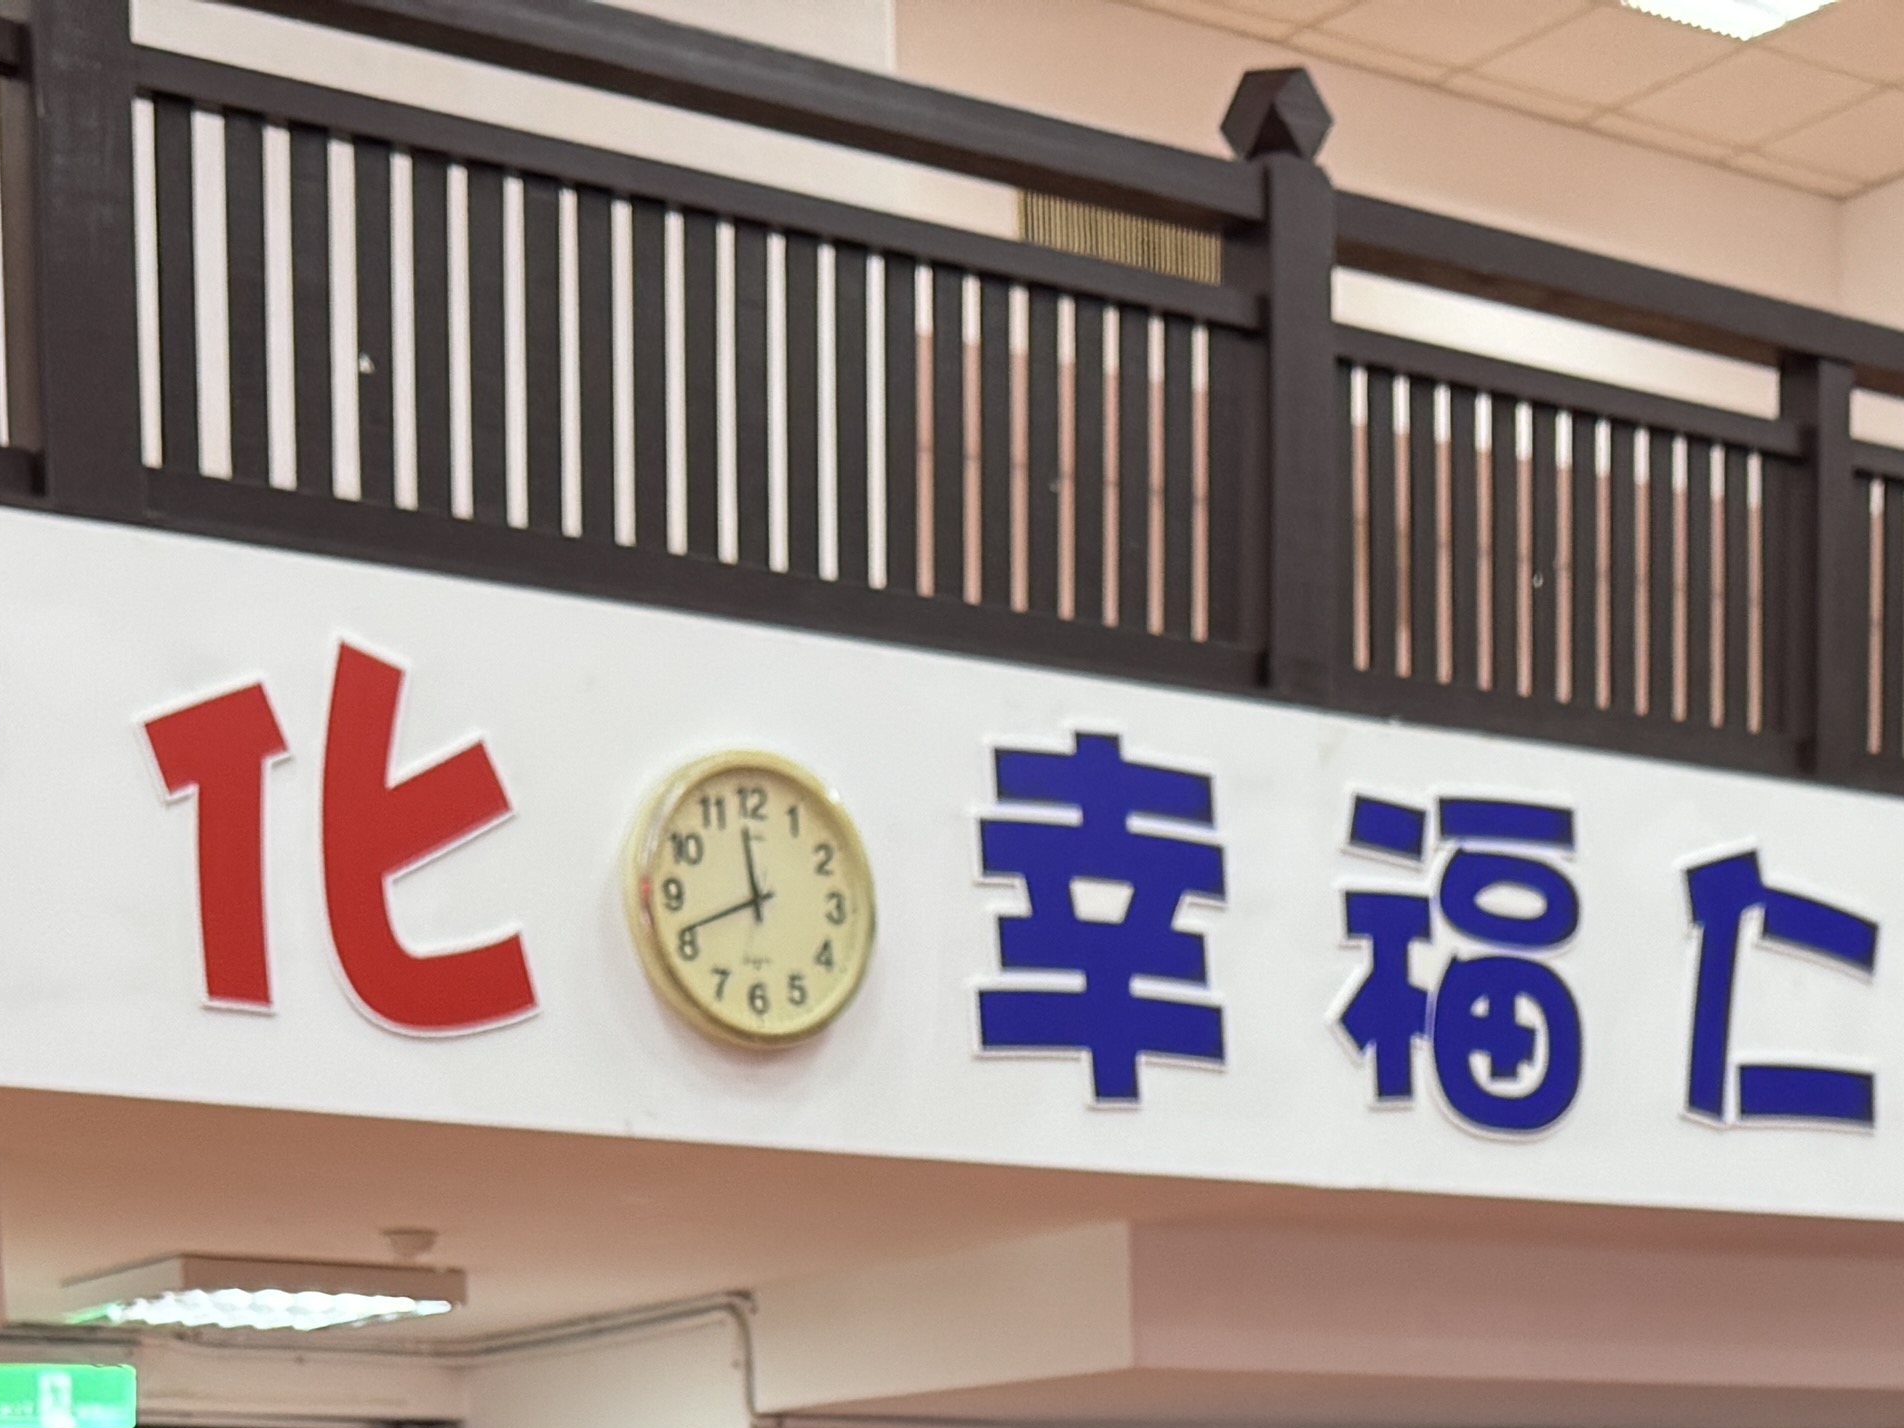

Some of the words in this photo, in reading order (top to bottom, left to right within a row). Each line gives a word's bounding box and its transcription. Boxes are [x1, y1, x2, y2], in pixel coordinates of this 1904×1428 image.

[699, 796, 727, 831] 11
[737, 787, 768, 821] 12
[786, 805, 800, 838] 1
[670, 832, 703, 866] 10
[814, 843, 834, 876] 2
[663, 878, 685, 912] 9
[826, 892, 846, 925] 3
[679, 928, 699, 961] 8
[815, 939, 834, 972] 4
[711, 968, 732, 1001] 7
[749, 982, 769, 1015] 6
[788, 973, 807, 1005] 5
